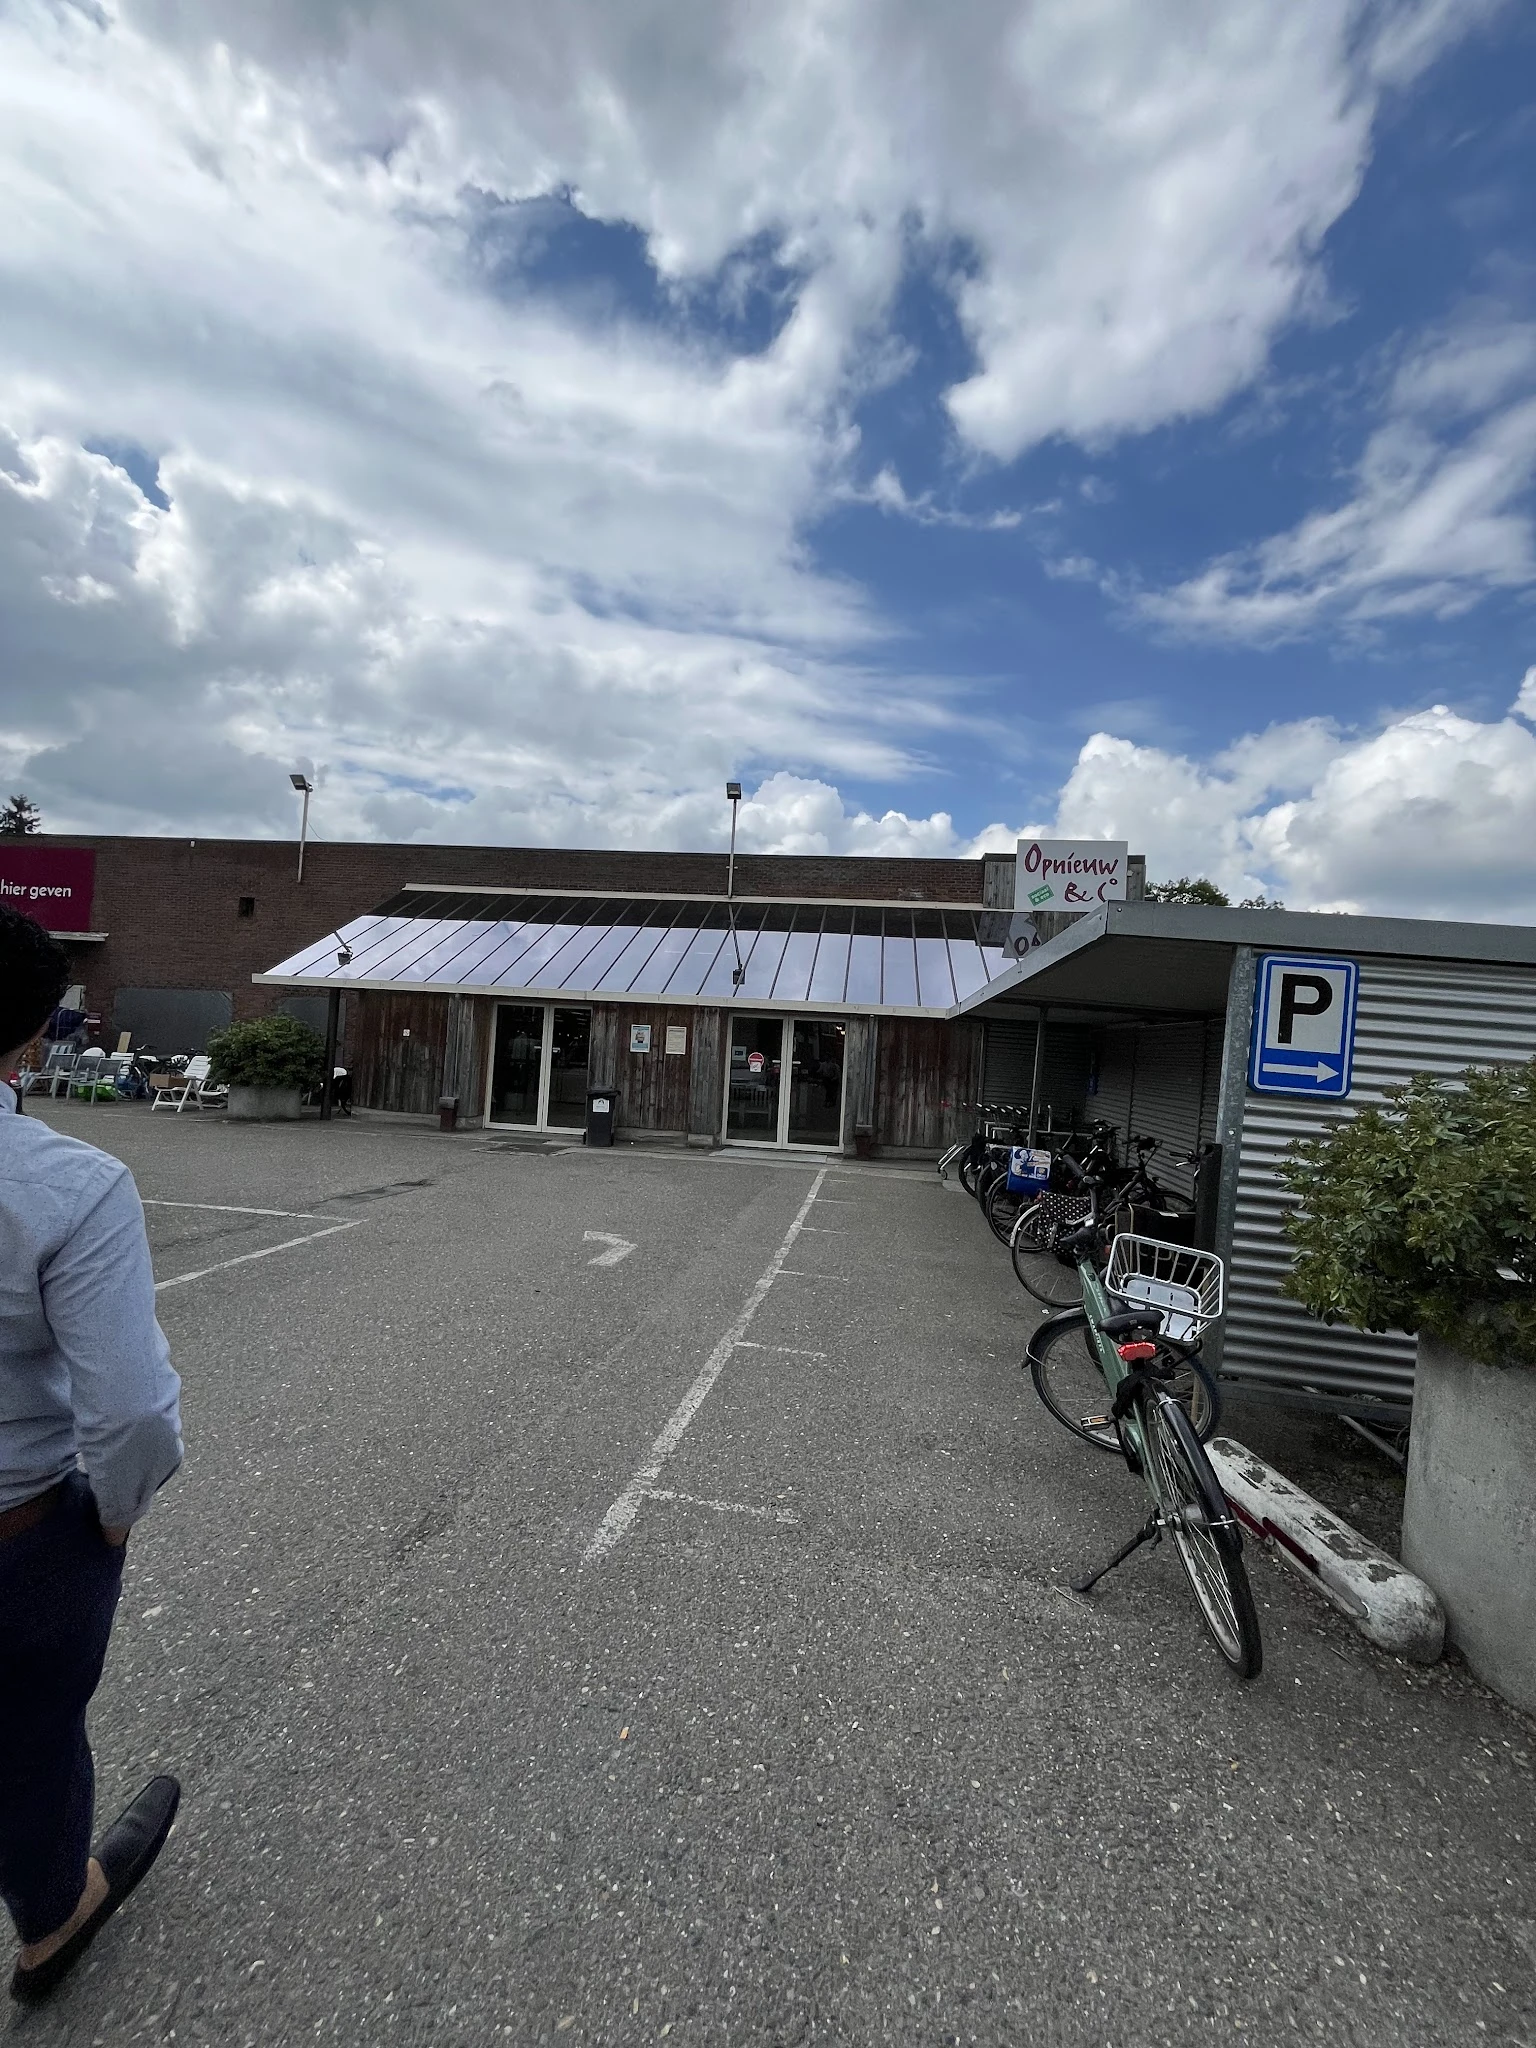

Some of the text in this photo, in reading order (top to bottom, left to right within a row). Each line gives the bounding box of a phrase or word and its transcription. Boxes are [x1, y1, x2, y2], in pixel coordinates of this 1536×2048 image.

[1024, 843, 1119, 880] Opnieuw
[0, 879, 72, 899] hier geven
[1064, 881, 1094, 902] &
[1277, 973, 1333, 1044] P
